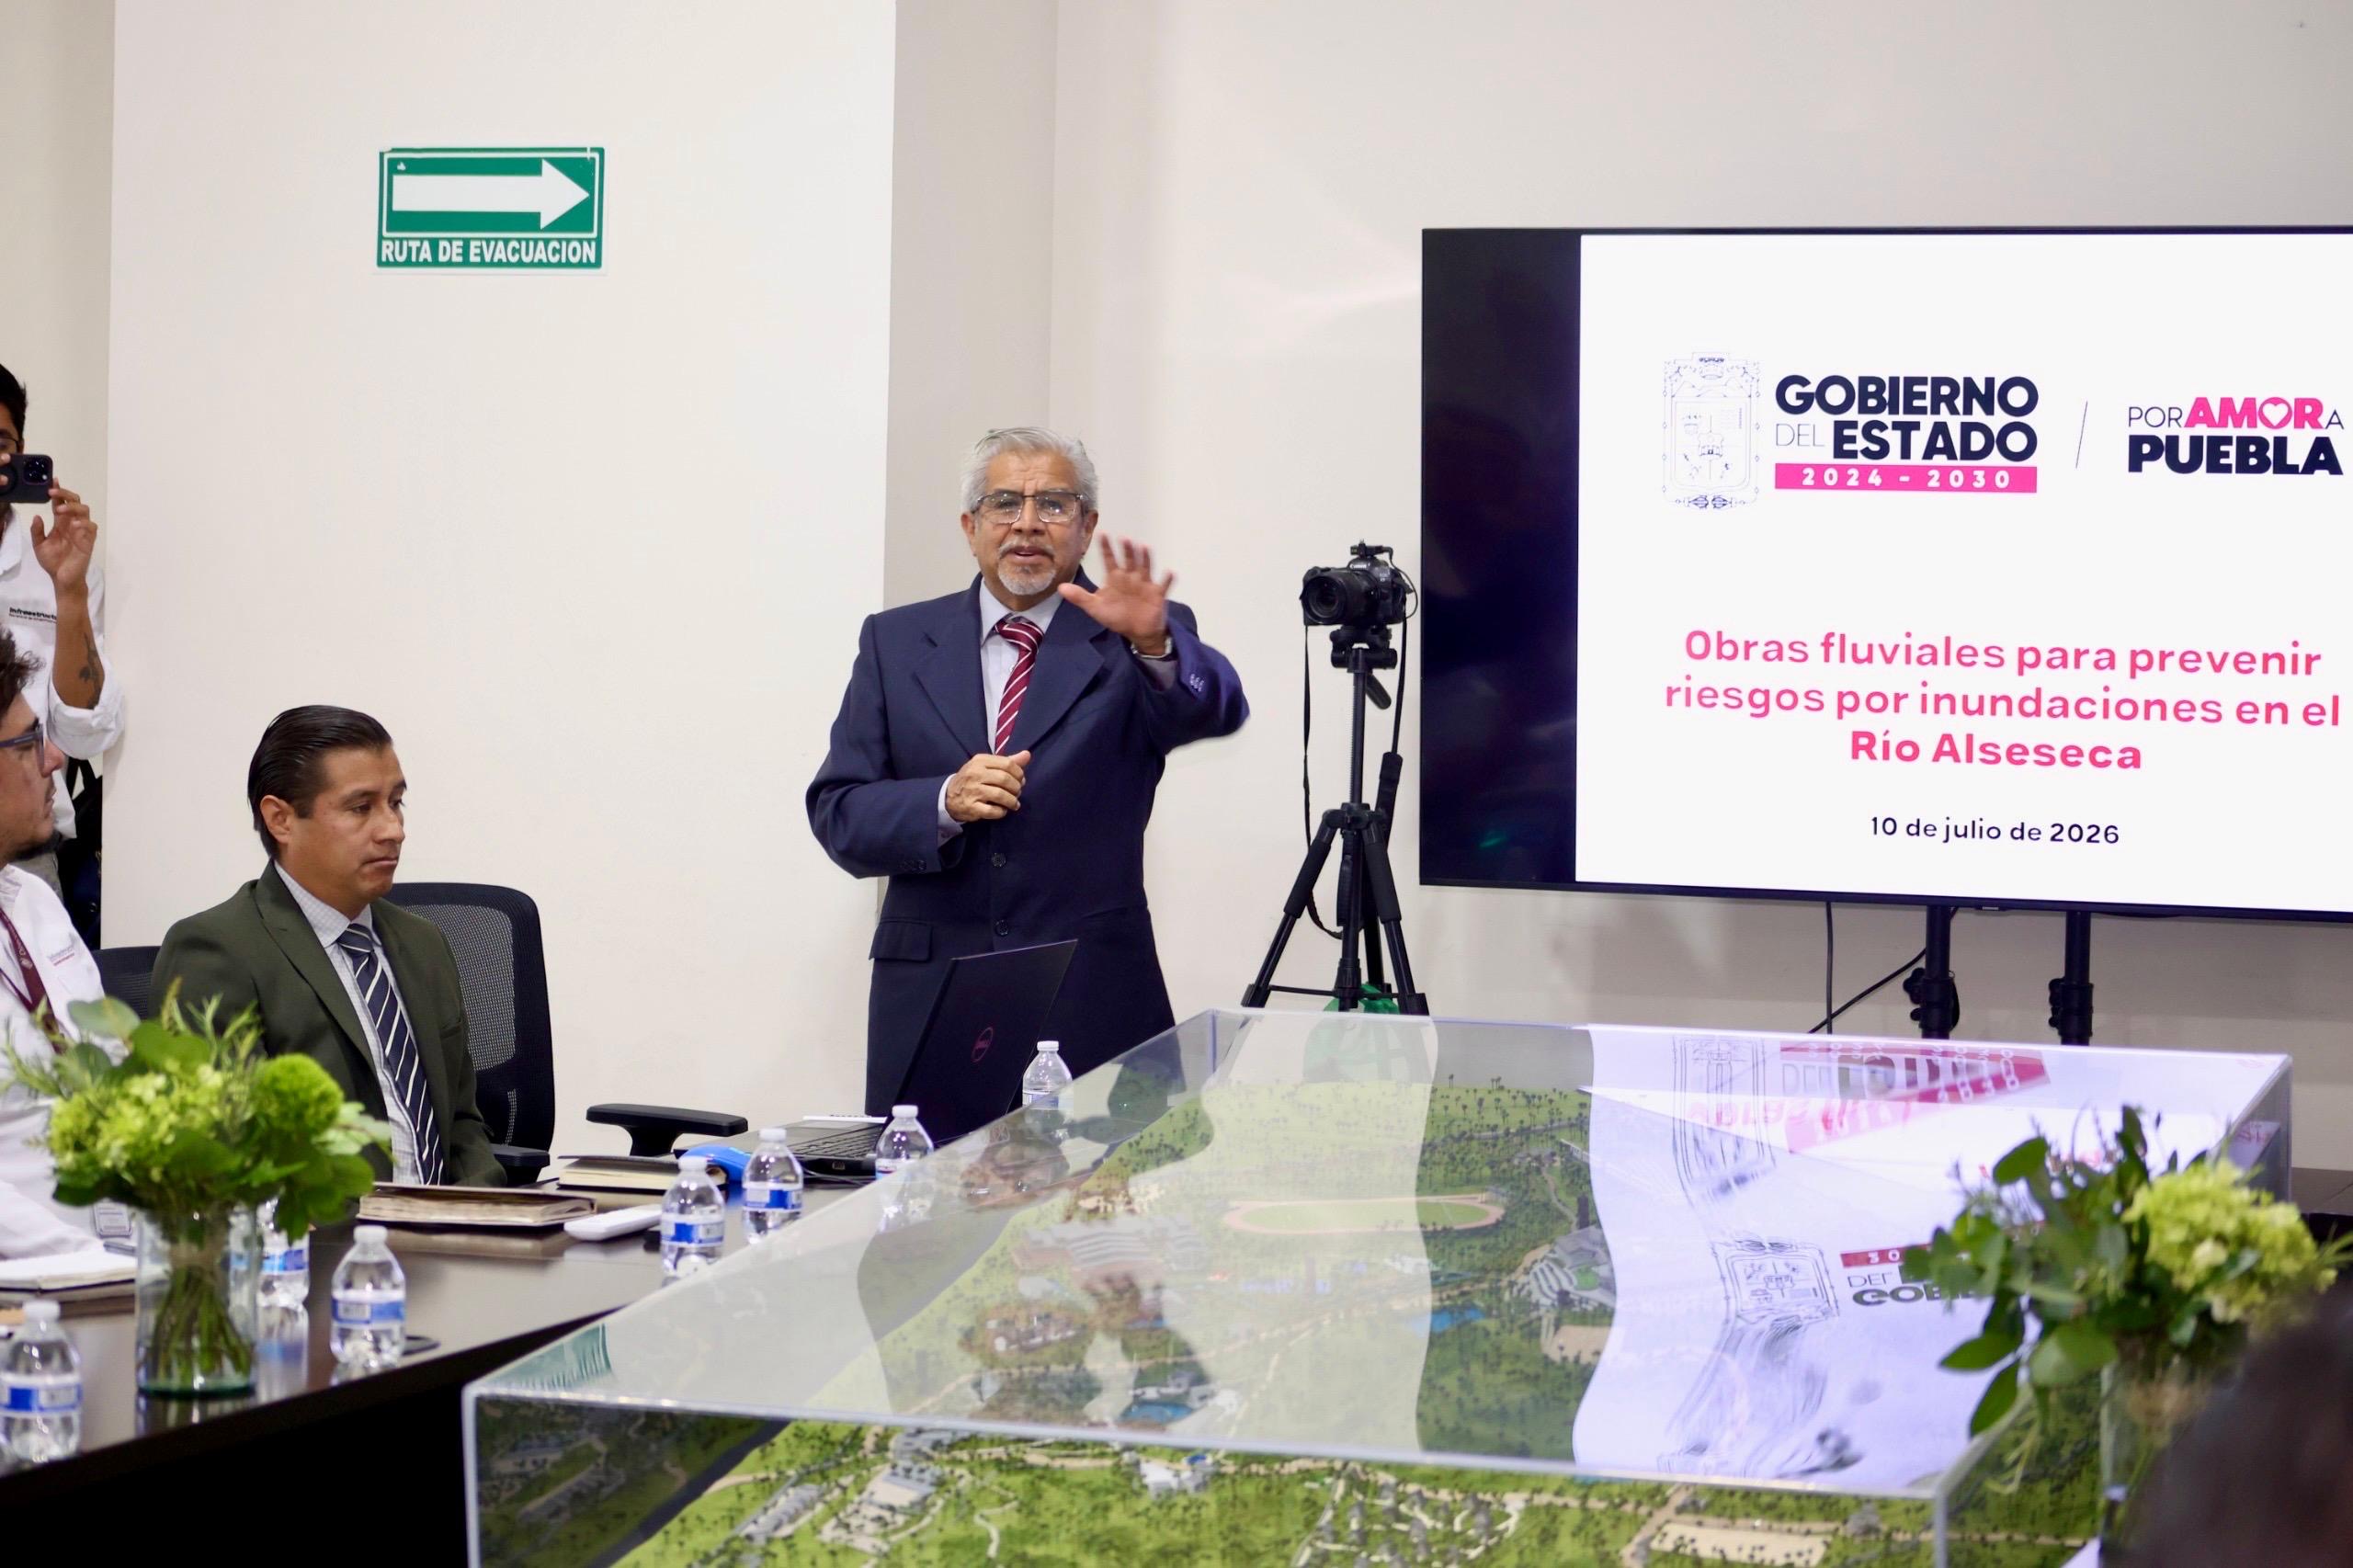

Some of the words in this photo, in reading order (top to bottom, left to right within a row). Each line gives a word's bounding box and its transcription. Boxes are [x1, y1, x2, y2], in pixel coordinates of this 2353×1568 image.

[381, 240, 432, 262] RUTA
[438, 240, 463, 262] DE
[470, 240, 596, 263] EVACUACION
[1775, 374, 2039, 416] GOBIERNO
[2128, 406, 2183, 428] POR
[2184, 396, 2324, 429] AMOR
[2325, 409, 2345, 429] A
[1776, 424, 1825, 447] DEL
[1833, 419, 2038, 462] ESTADO
[2128, 435, 2344, 475] PUEBLA
[1802, 467, 1882, 486] 2024
[1927, 470, 2010, 489] 2030
[1686, 630, 1809, 663] Obras
[1820, 631, 2005, 668] fluviales
[2018, 646, 2116, 676] para
[2129, 640, 2322, 679] prevenir
[1666, 675, 1824, 719] riesgos
[1836, 690, 1909, 721] por
[1920, 680, 2222, 723] inundaciones
[2235, 700, 2289, 725] en
[2302, 695, 2339, 726] el
[1851, 730, 1920, 762] Río
[1931, 733, 2142, 769] Alseseca
[1871, 817, 1897, 835] 10
[1905, 818, 1937, 837] de
[1942, 816, 2001, 844] julio
[2010, 822, 2041, 841] de
[2050, 823, 2119, 844] 2026
